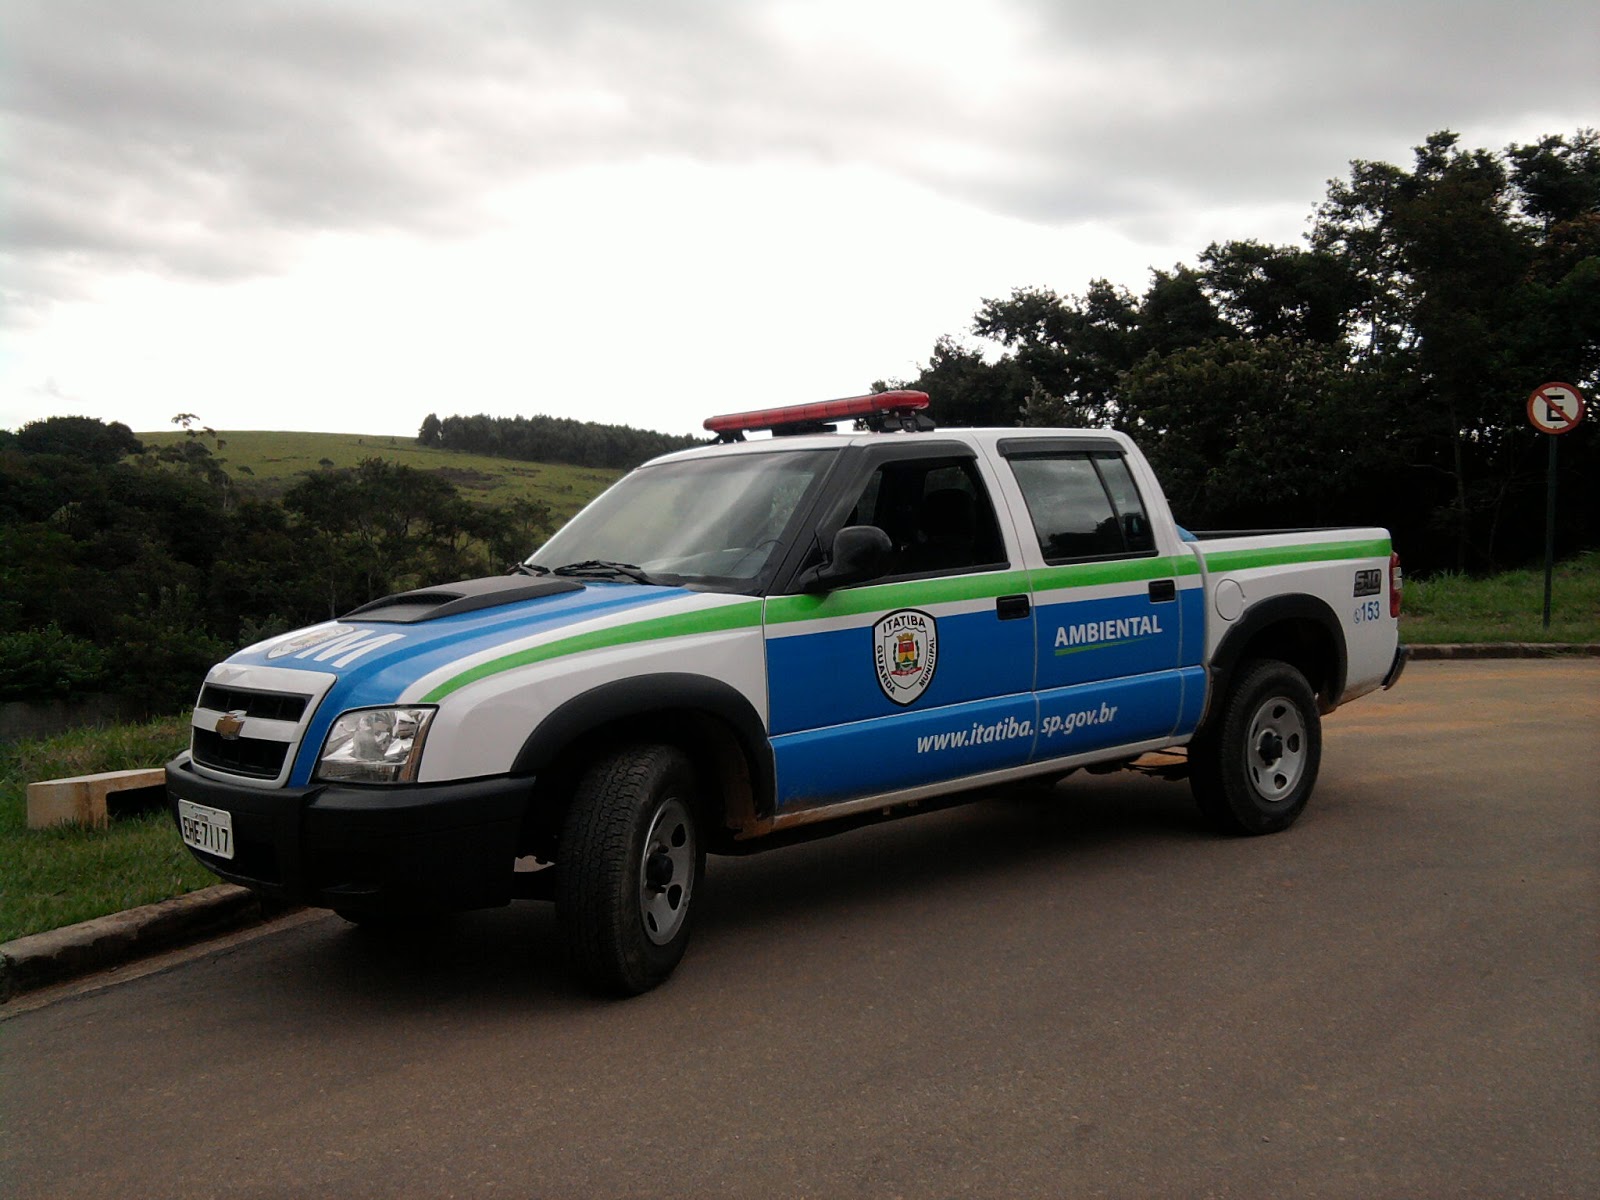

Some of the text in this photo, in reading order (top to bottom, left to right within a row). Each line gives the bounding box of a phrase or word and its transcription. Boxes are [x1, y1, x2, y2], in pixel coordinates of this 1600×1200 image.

[883, 615, 926, 633] ITATIBA
[1361, 601, 1380, 621] 153
[1054, 615, 1163, 647] AMBIENTAL
[877, 644, 896, 695] GUARDA
[918, 636, 935, 688] MUNICIPAL
